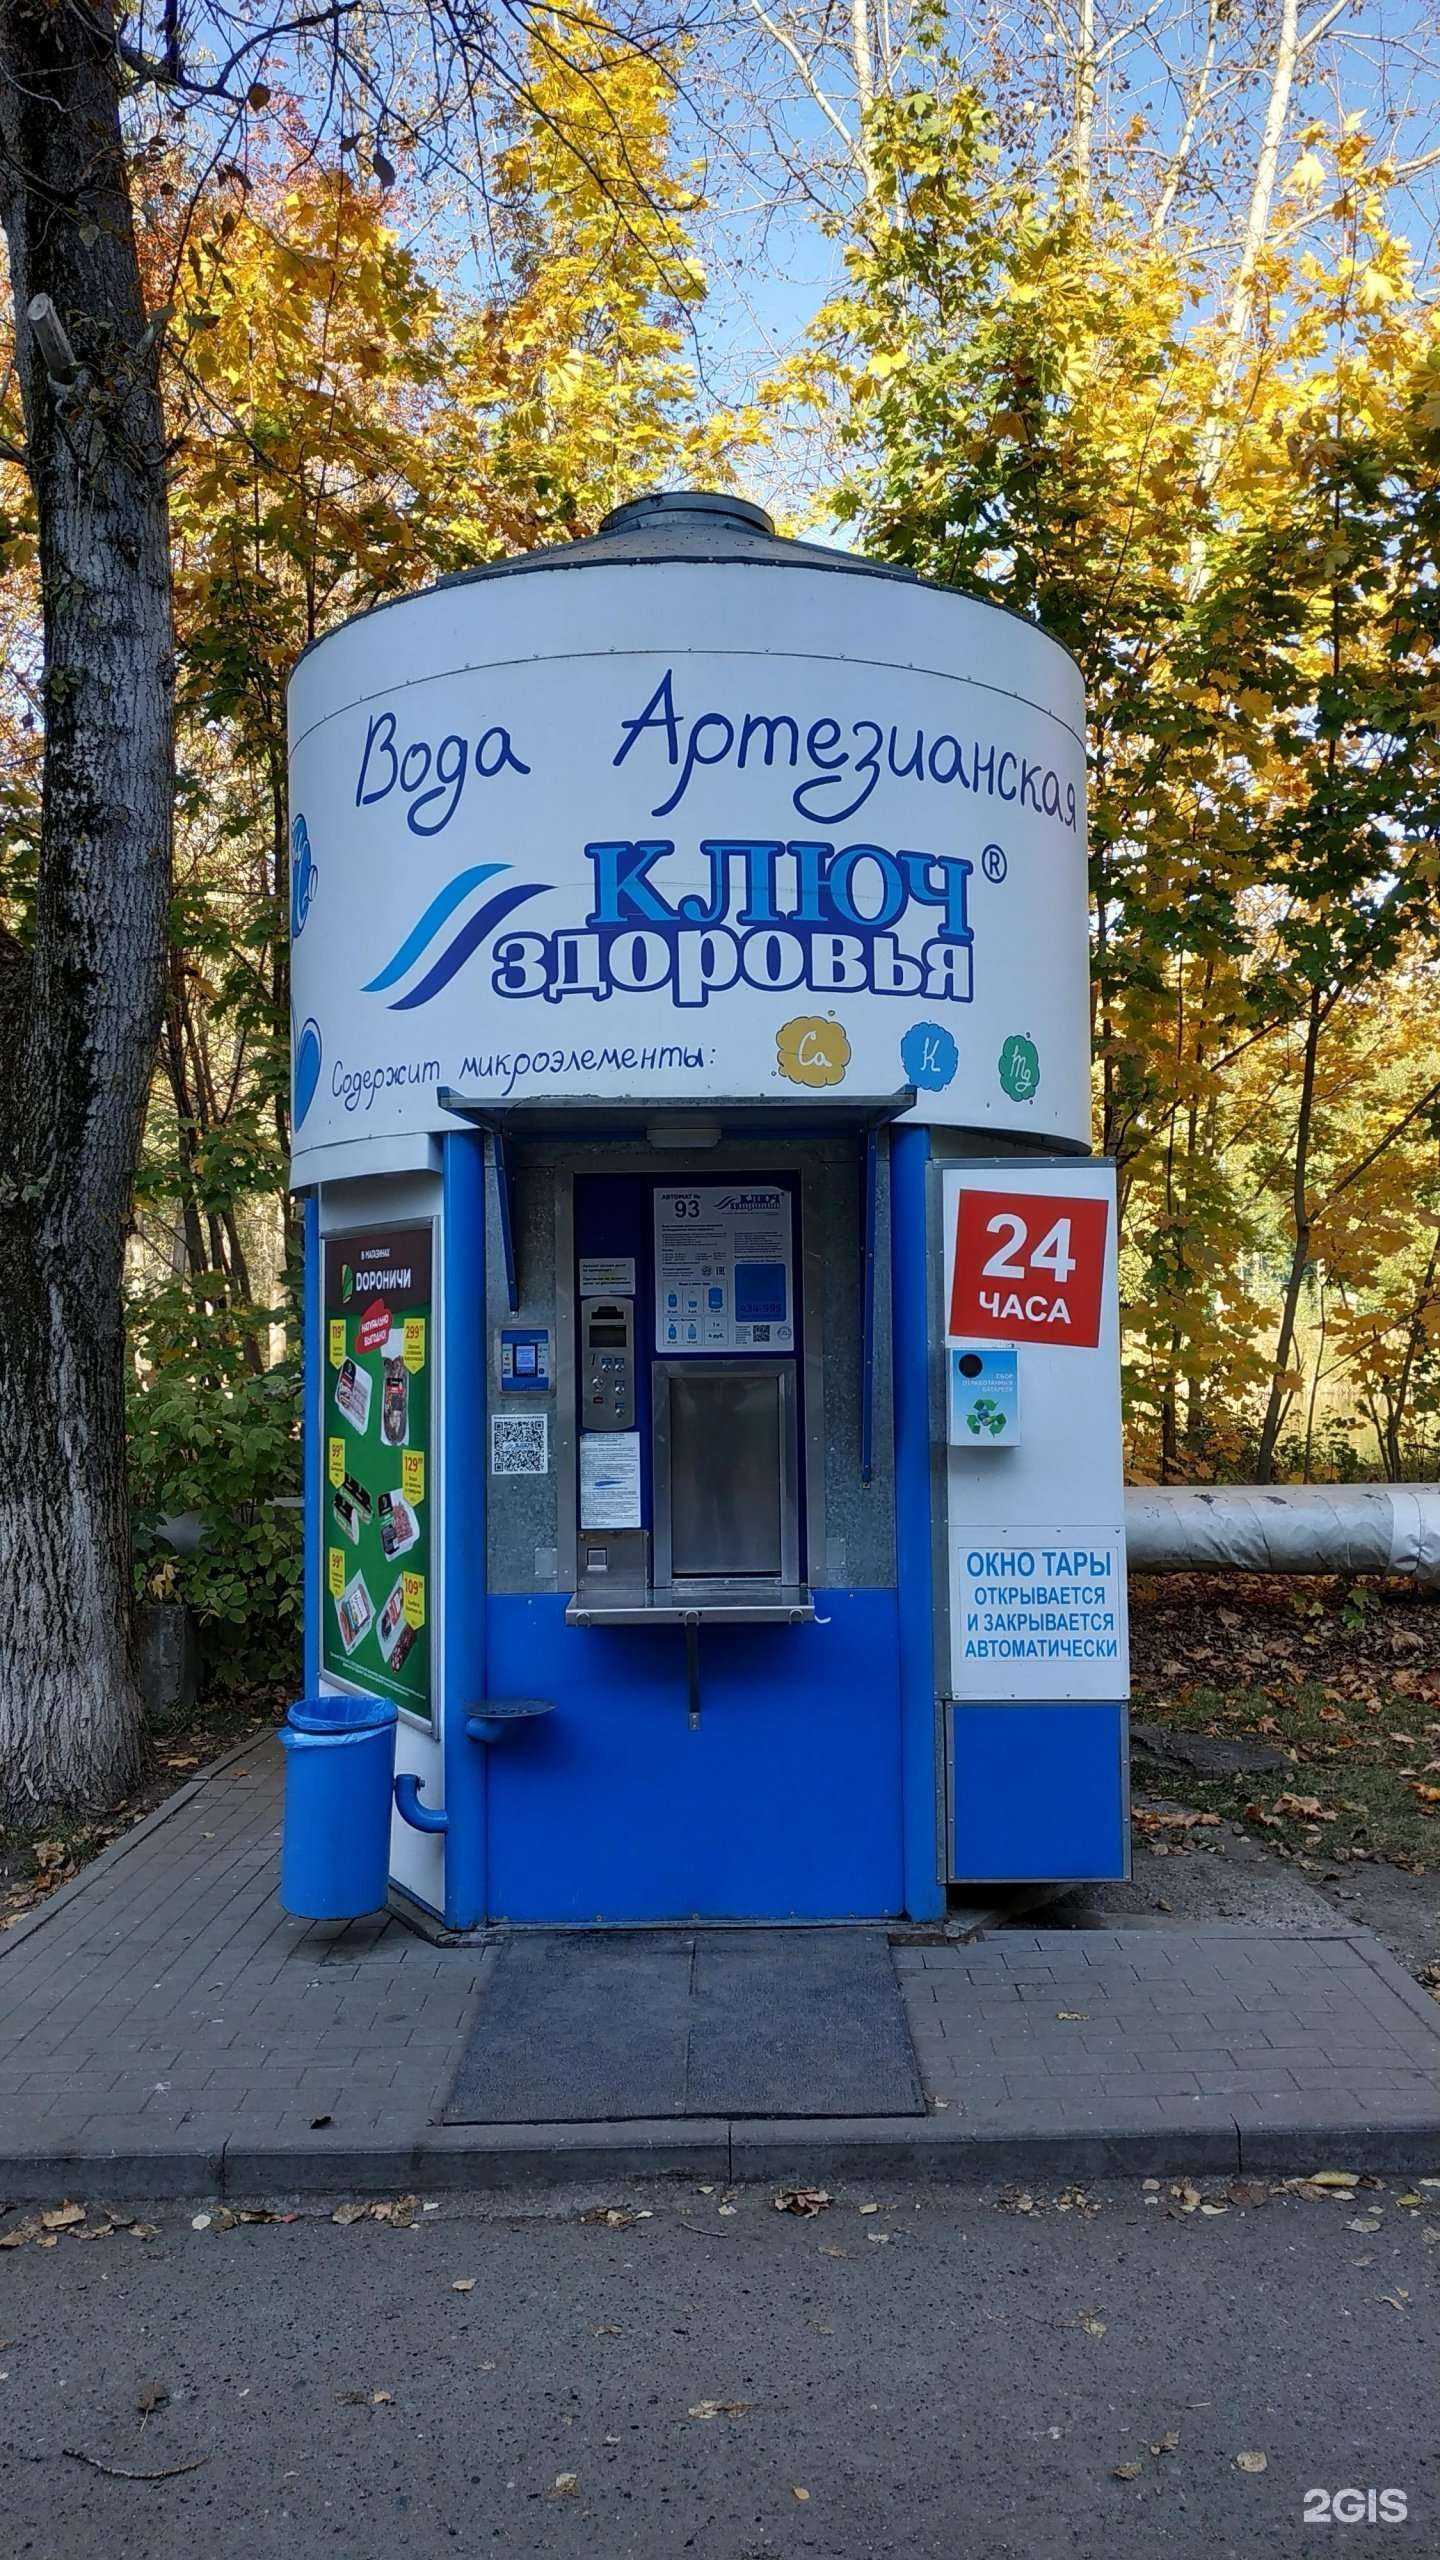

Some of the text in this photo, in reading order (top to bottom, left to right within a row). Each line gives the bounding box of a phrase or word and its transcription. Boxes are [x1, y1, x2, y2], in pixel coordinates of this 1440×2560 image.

[356, 668, 1078, 837] Вода Артезианская
[584, 840, 974, 942] КЛЮЧ
[492, 926, 974, 1008] здоровья
[331, 1042, 716, 1112] Содержит микроэлементы:
[674, 1199, 700, 1218] 93
[981, 1213, 1076, 1283] 24
[978, 1291, 1072, 1324] ЧАСА
[967, 1551, 1111, 1577] ОКНО ТАРЫ
[974, 1587, 1105, 1605] ОТКРЫВАЕТСЯ
[967, 1613, 1114, 1631] И ЗАКРЫВАЕТСЯ
[965, 1639, 1117, 1658] АВТОМАТИЧЕСКИ
